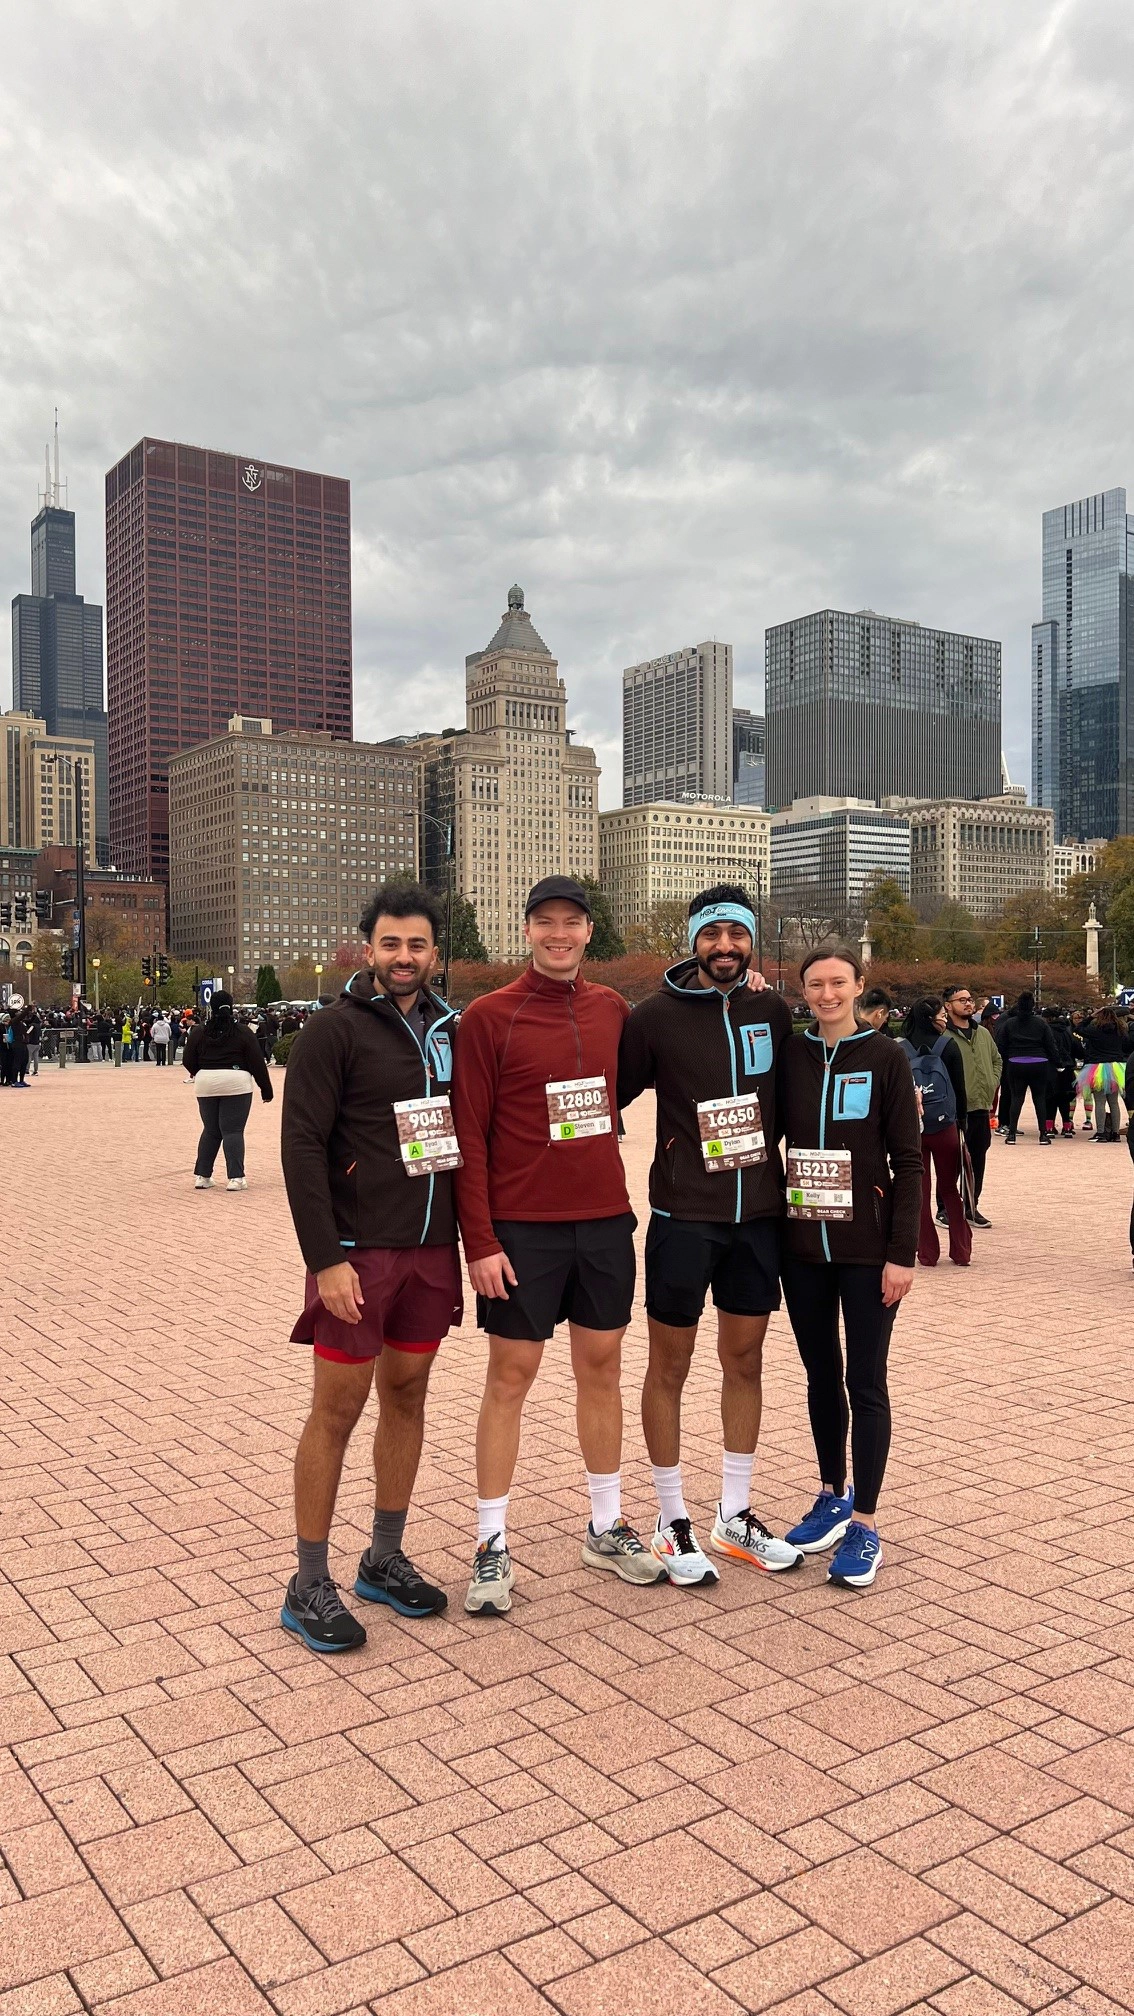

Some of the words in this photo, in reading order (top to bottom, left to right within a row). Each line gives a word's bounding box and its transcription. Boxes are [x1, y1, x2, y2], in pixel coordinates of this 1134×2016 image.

[682, 792, 731, 802] MOTOROLA
[558, 1090, 602, 1110] 12880
[408, 1110, 444, 1129] 9043
[708, 1106, 755, 1128] 16650
[564, 1126, 571, 1135] D
[574, 1122, 594, 1130] Steven
[411, 1146, 419, 1156] A
[711, 1144, 719, 1153] A
[796, 1162, 839, 1177] 15212
[794, 1193, 799, 1201] F
[725, 1528, 769, 1553] BROOKS
